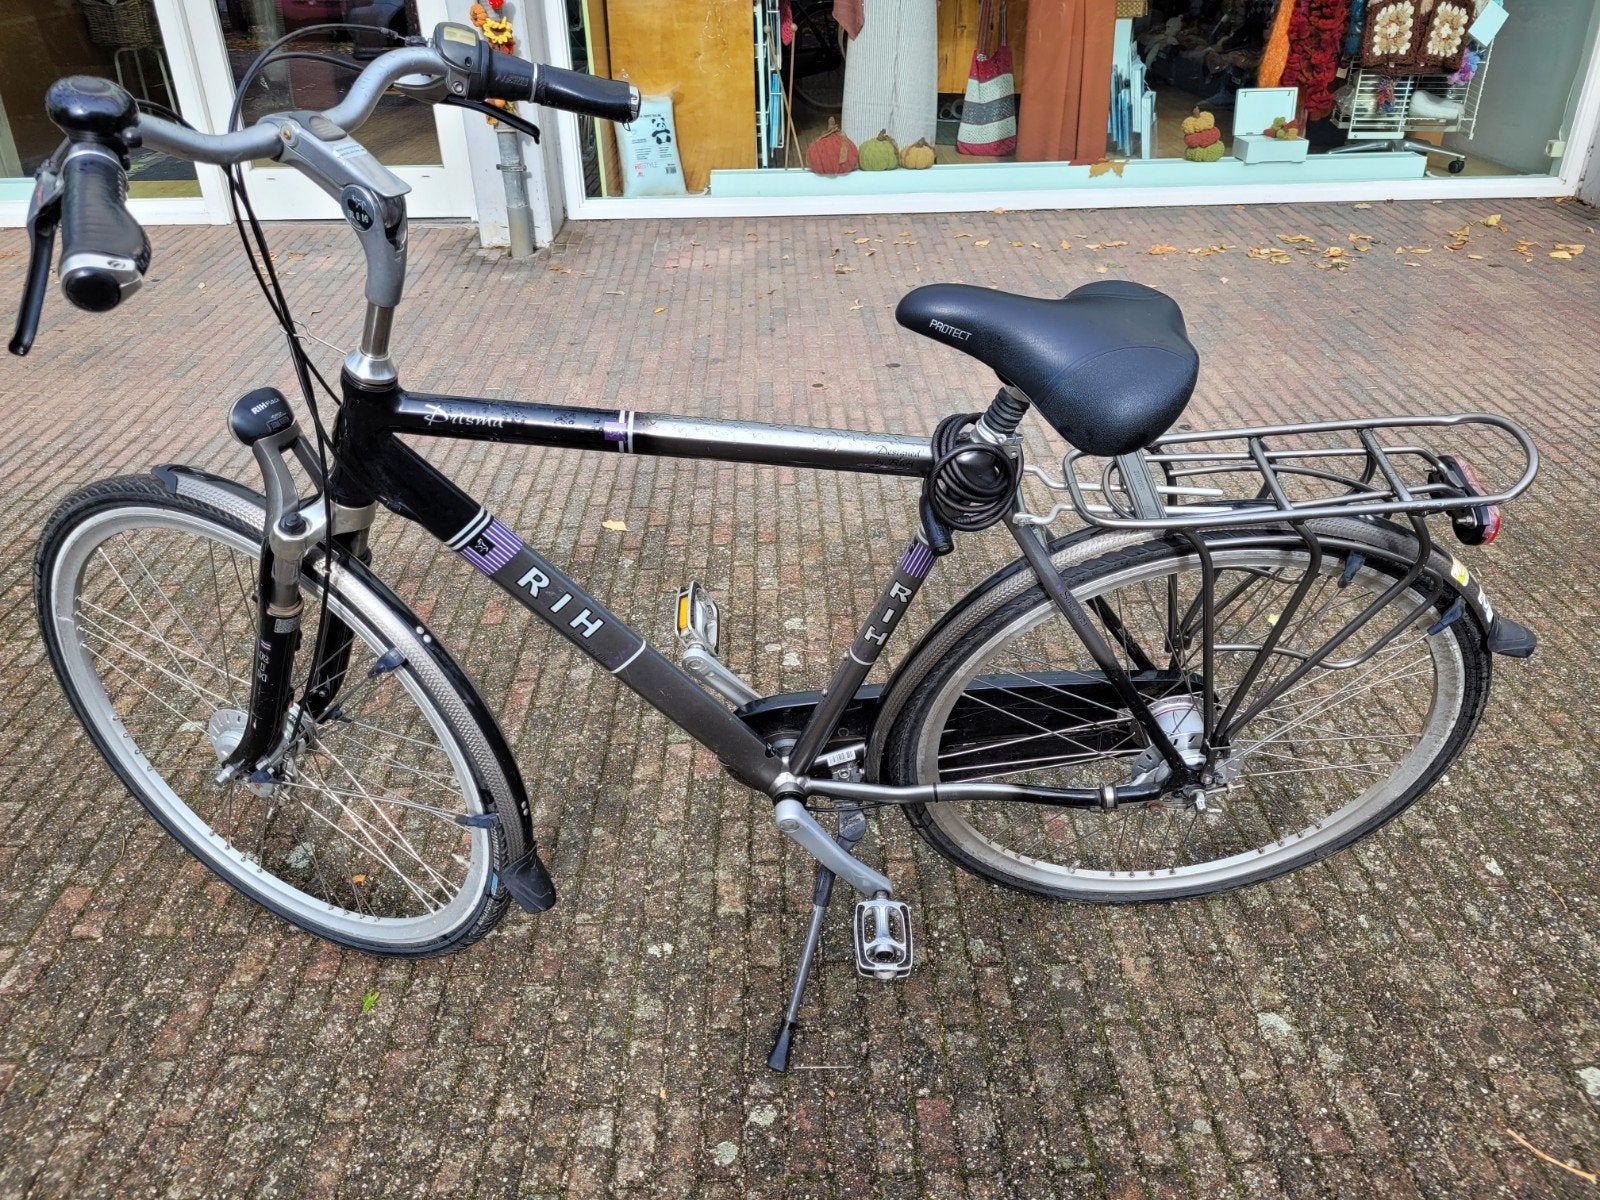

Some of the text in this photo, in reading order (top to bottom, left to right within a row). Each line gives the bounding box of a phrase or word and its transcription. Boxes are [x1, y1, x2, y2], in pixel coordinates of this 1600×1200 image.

[929, 319, 973, 340] PROTECT
[516, 566, 605, 638] RIH
[864, 581, 912, 646] RIH
